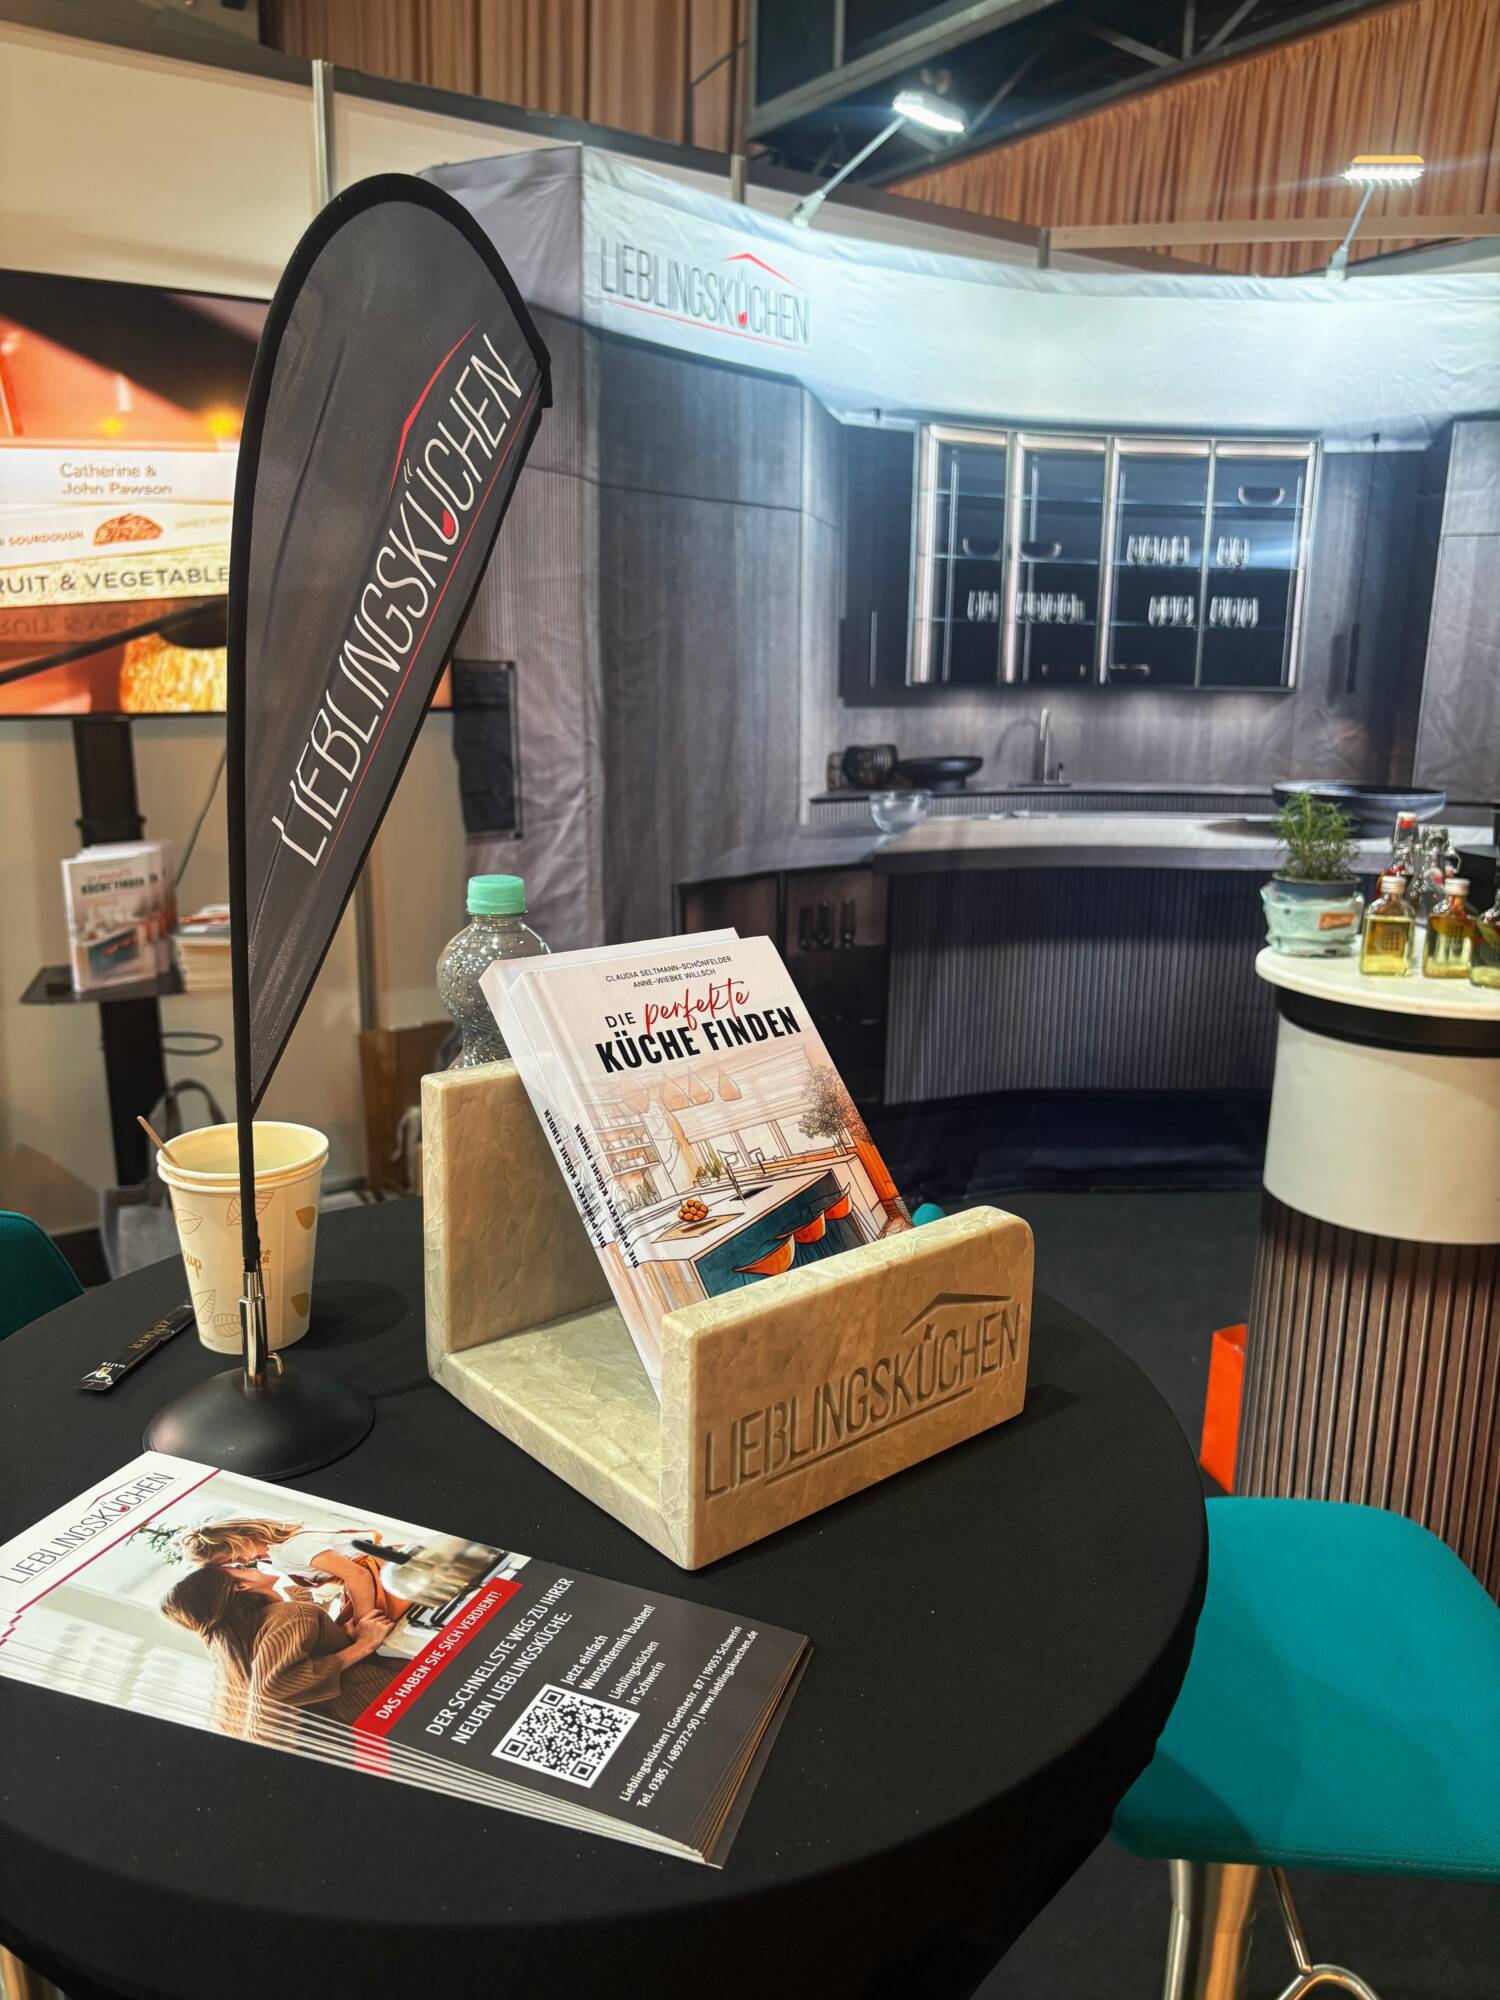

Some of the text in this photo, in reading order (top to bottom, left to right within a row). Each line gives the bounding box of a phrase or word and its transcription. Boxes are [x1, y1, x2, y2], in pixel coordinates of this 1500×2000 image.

[600, 238, 809, 344] LIEBLINGSKÜCHEN
[59, 462, 157, 479] Catherine &
[61, 483, 173, 496] John Pawson
[8, 530, 84, 546] SOURDOUGH
[60, 574, 77, 592] &
[271, 334, 522, 867] LIEBLINGSKÜCHEN
[605, 955, 733, 983] CLAUDIA SELTMANN-SCHÖNFELDER
[633, 968, 717, 989] ANNE-WIEBKE WILLSCH
[604, 977, 750, 1035] DIE perfekte
[594, 1005, 802, 1073] KÜCHE FINDEN
[543, 1108, 562, 1145] FINDEN
[574, 1123, 593, 1161] FINDEN
[559, 1145, 578, 1180] KÜCHE
[590, 1162, 609, 1197] KÜCHE
[594, 1230, 607, 1249] DIE
[627, 1249, 640, 1269] DIE
[704, 1302, 1022, 1500] LIEBLINGSKÜCHEN
[0, 1472, 175, 1585] LIEBLINGSKÜCHEN
[375, 1590, 503, 1720] DAS HABEN SIE SICH VERDIENT!
[425, 1577, 575, 1736] DER SCHNELLSTE WEG ZU IHRER
[560, 1634, 609, 1686] Jetzt einfach
[578, 1603, 656, 1691] Wunschtermin buchen!
[608, 1640, 660, 1700] Lieblingsküchen
[451, 1611, 573, 1745] NEUEN LIEBLINGSKÜCHE:
[625, 1661, 666, 1706] in Schwerin
[619, 1731, 670, 1802] Lieblingsküchen
[666, 1690, 701, 1730] Goethestr.
[692, 1677, 705, 1691] 87
[701, 1653, 724, 1680] 19053
[714, 1625, 743, 1656] Schwerin
[636, 1791, 655, 1808] Tel.
[647, 1766, 670, 1792] 0385
[666, 1716, 702, 1764] 489372-90
[697, 1629, 759, 1718] www.lieblingskuechen.de
